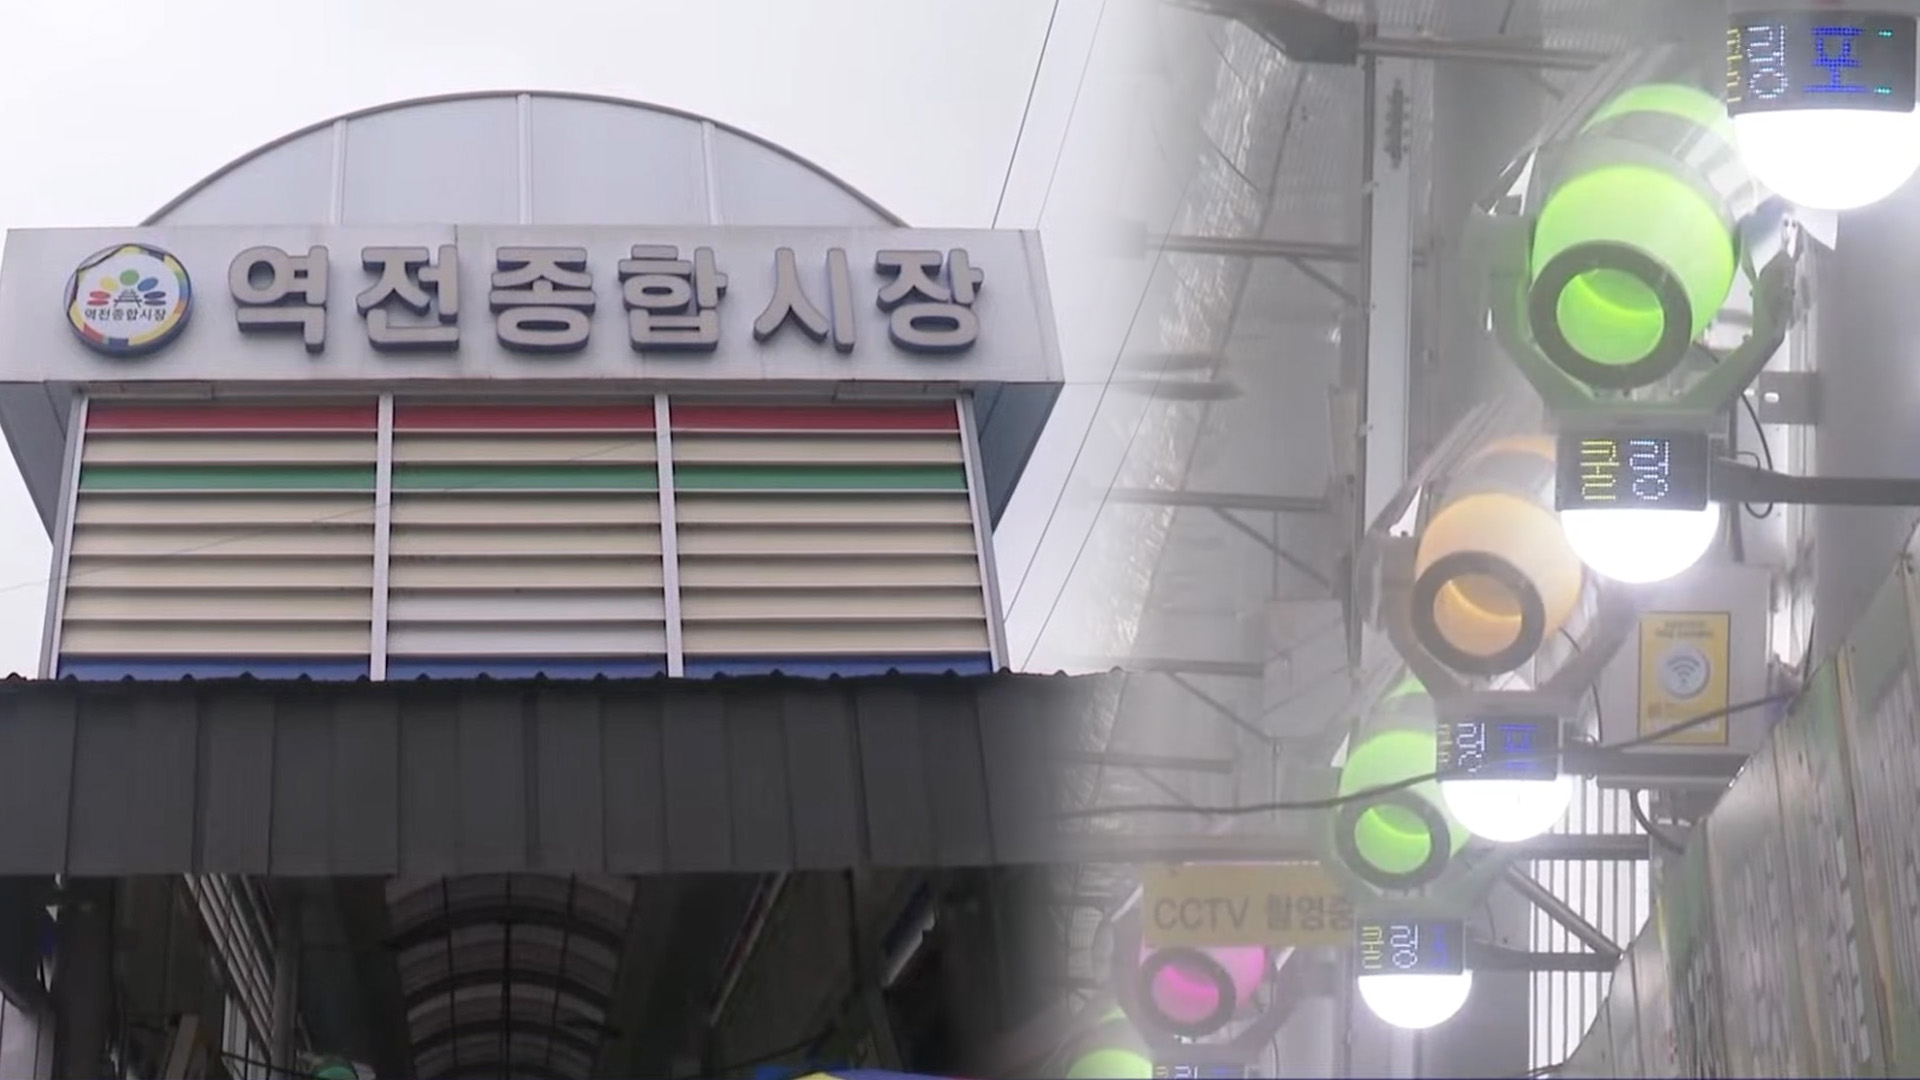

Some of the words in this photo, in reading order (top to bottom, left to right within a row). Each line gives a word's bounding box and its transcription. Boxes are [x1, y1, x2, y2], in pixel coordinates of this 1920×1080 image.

[84, 308, 167, 321] 역전종합시장
[228, 245, 984, 354] 역전종합시장
[1153, 897, 1249, 931] CCTV
